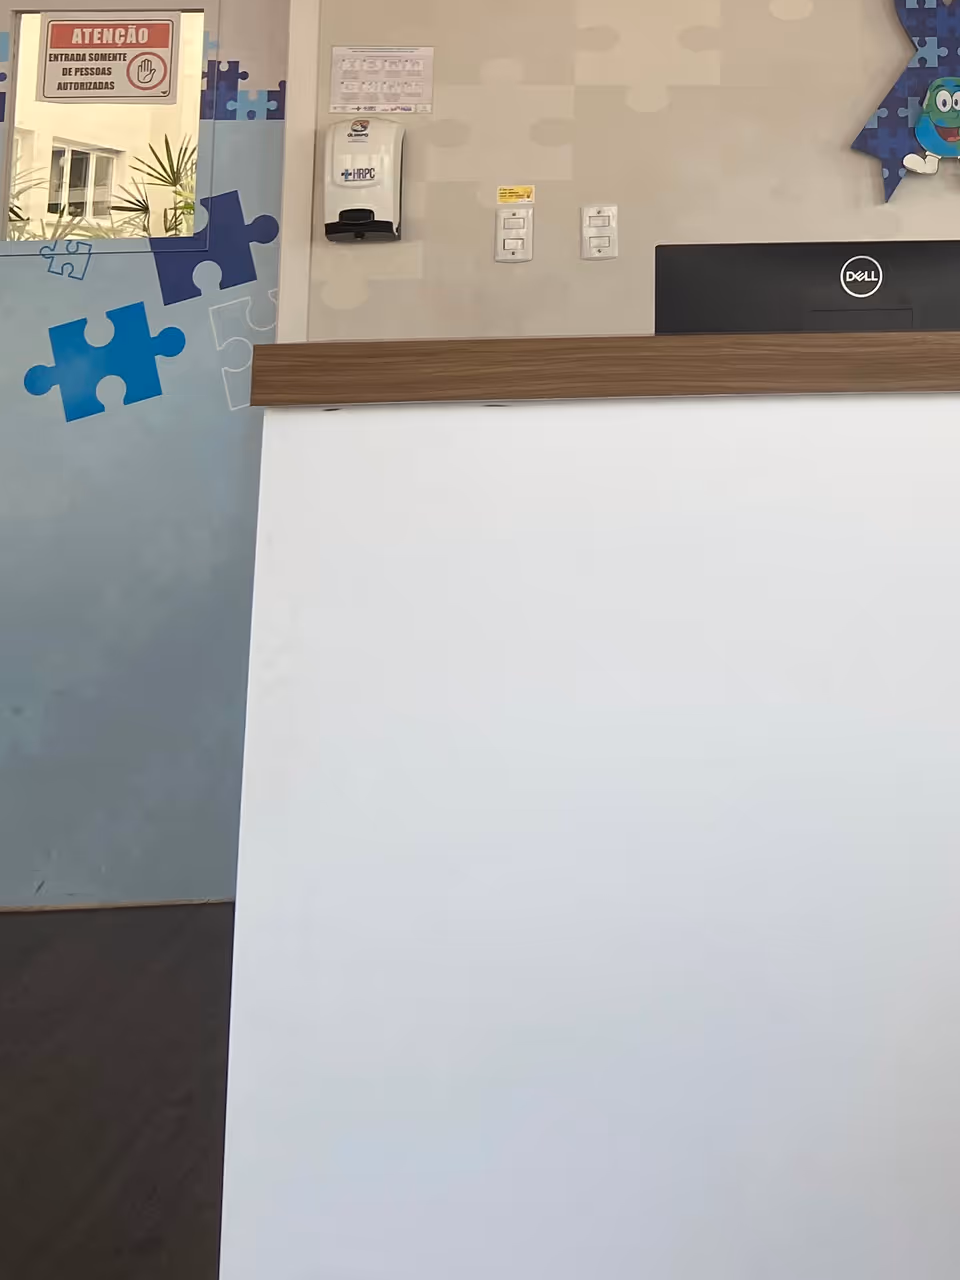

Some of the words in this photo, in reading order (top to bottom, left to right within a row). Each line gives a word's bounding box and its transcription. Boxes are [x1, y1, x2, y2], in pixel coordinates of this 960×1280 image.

[71, 24, 149, 47] ATENÇÃO
[49, 53, 87, 62] ENTRADA
[88, 52, 127, 62] SOMENTE
[62, 67, 73, 77] DE
[74, 66, 112, 77] PESSOAS
[57, 81, 115, 91] AUTORIZADAS
[352, 168, 376, 180] HRPC
[846, 270, 879, 282] DELL
